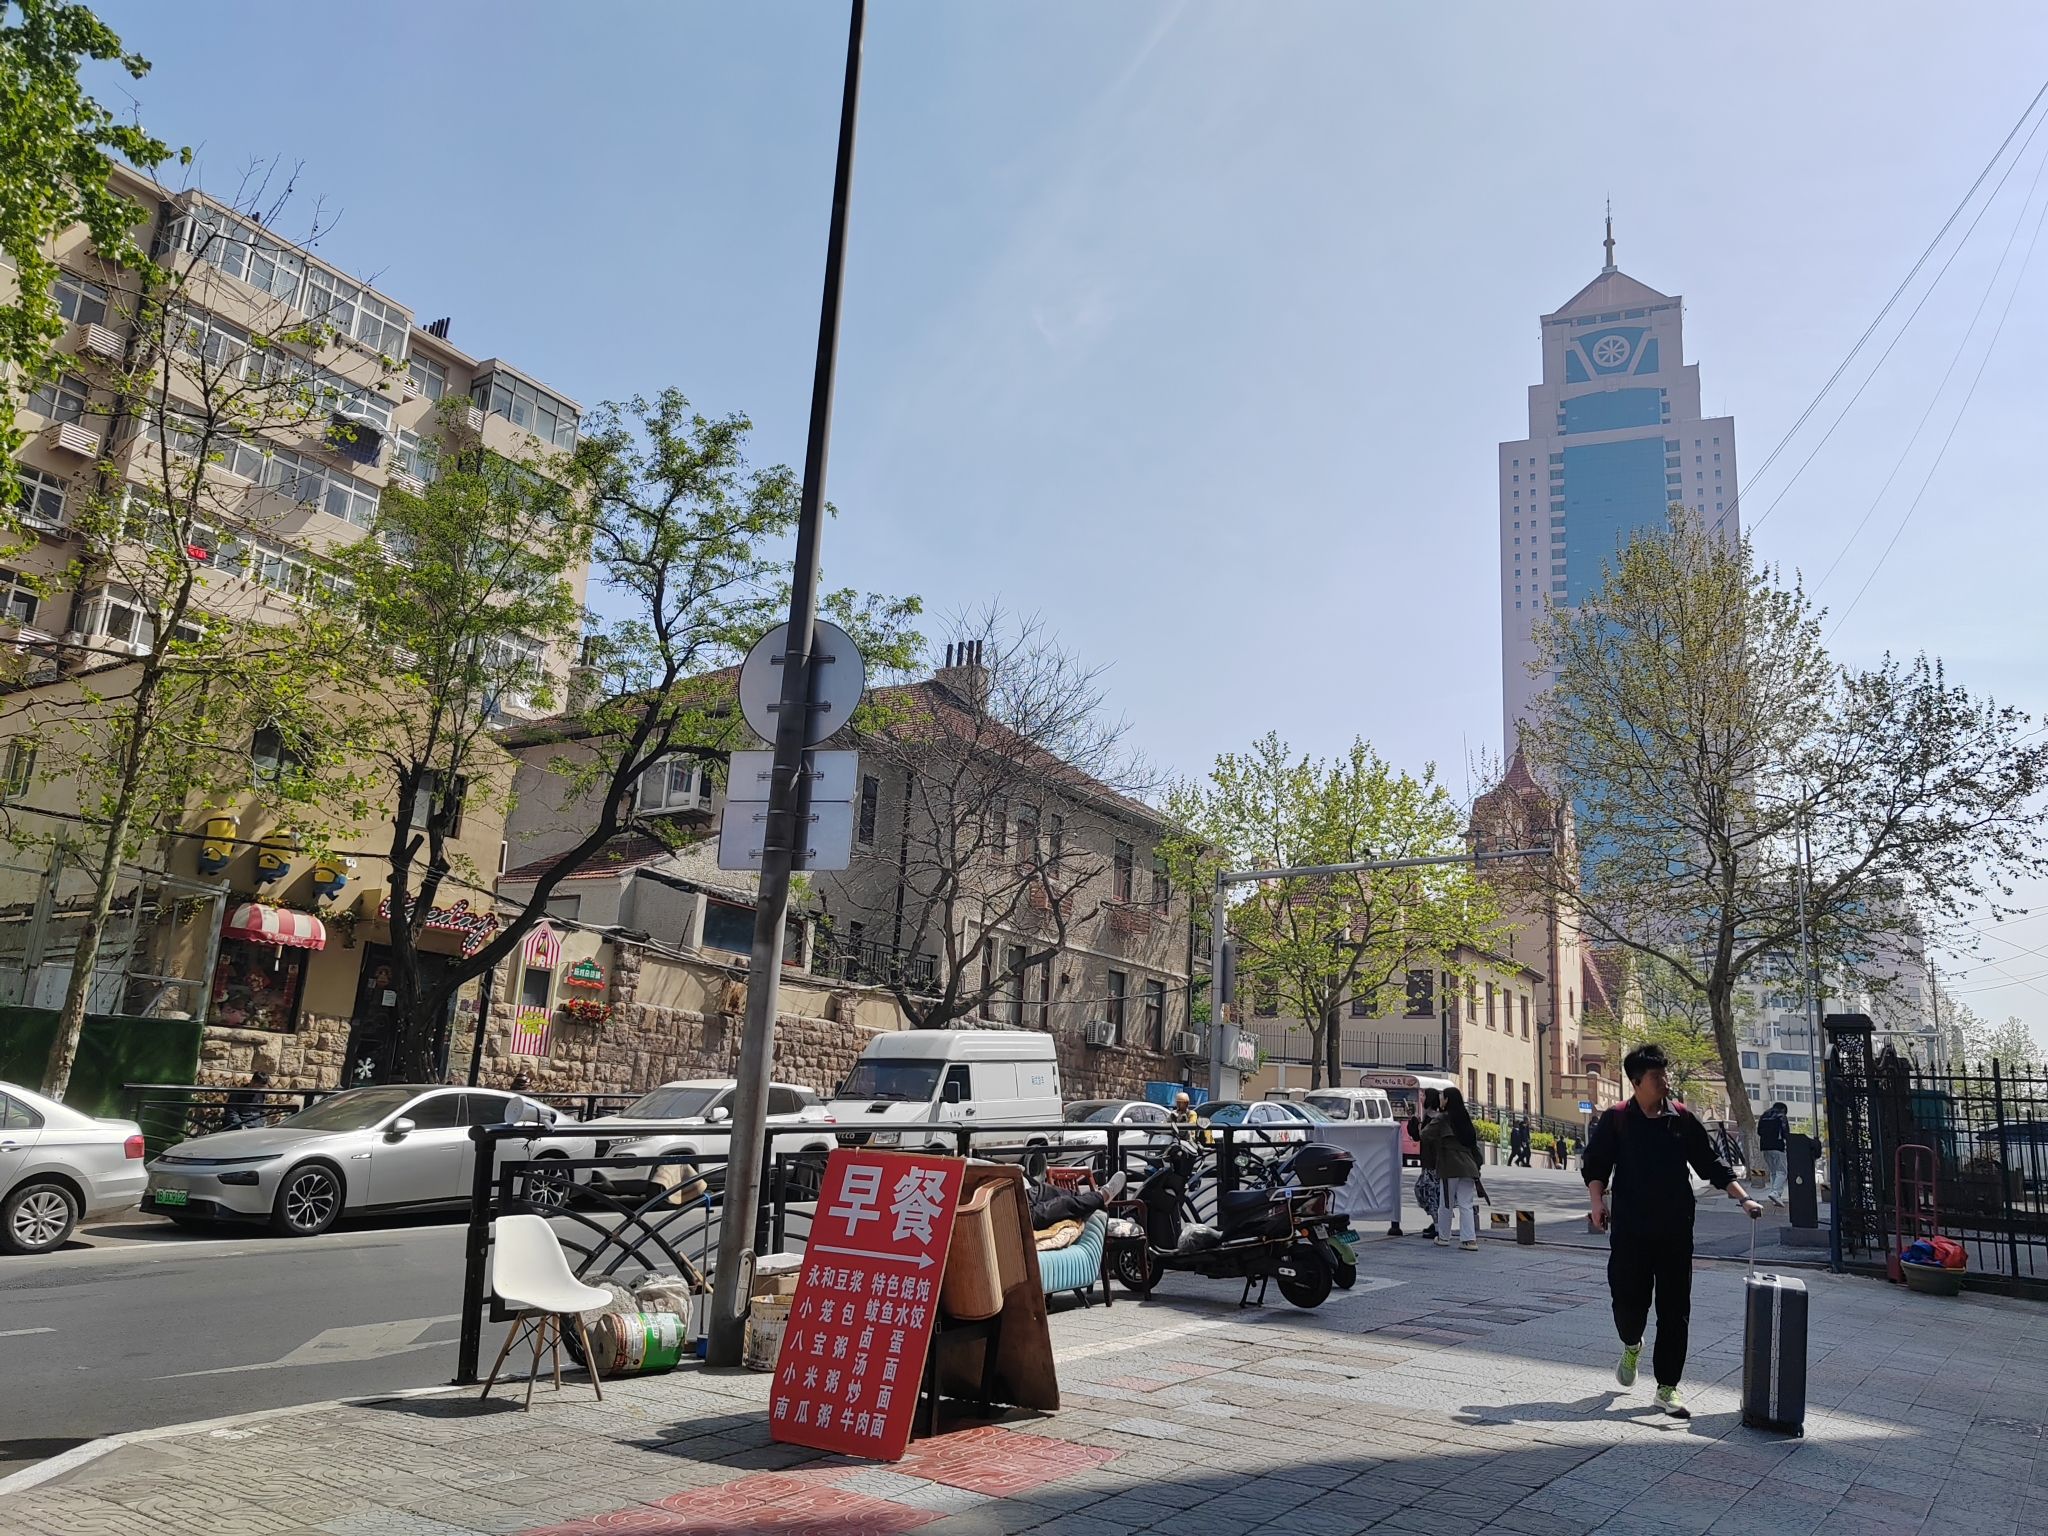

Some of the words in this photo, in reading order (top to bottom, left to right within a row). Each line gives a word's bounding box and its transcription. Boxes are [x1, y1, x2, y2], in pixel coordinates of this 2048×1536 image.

[828, 1164, 947, 1245] 早餐
[807, 1265, 864, 1292] 永和豆浆
[871, 1272, 931, 1302] 特色馄饨
[799, 1297, 855, 1326] 小笼包
[864, 1299, 925, 1328] 鲅鱼水饺
[790, 1330, 848, 1359] 八宝粥
[859, 1325, 904, 1353] 卤蛋
[783, 1362, 840, 1393] 小米粥
[852, 1352, 899, 1381] 汤面
[846, 1379, 893, 1410] 炒面
[774, 1396, 832, 1428] 南瓜粥
[841, 1407, 886, 1438] 牛肉面
